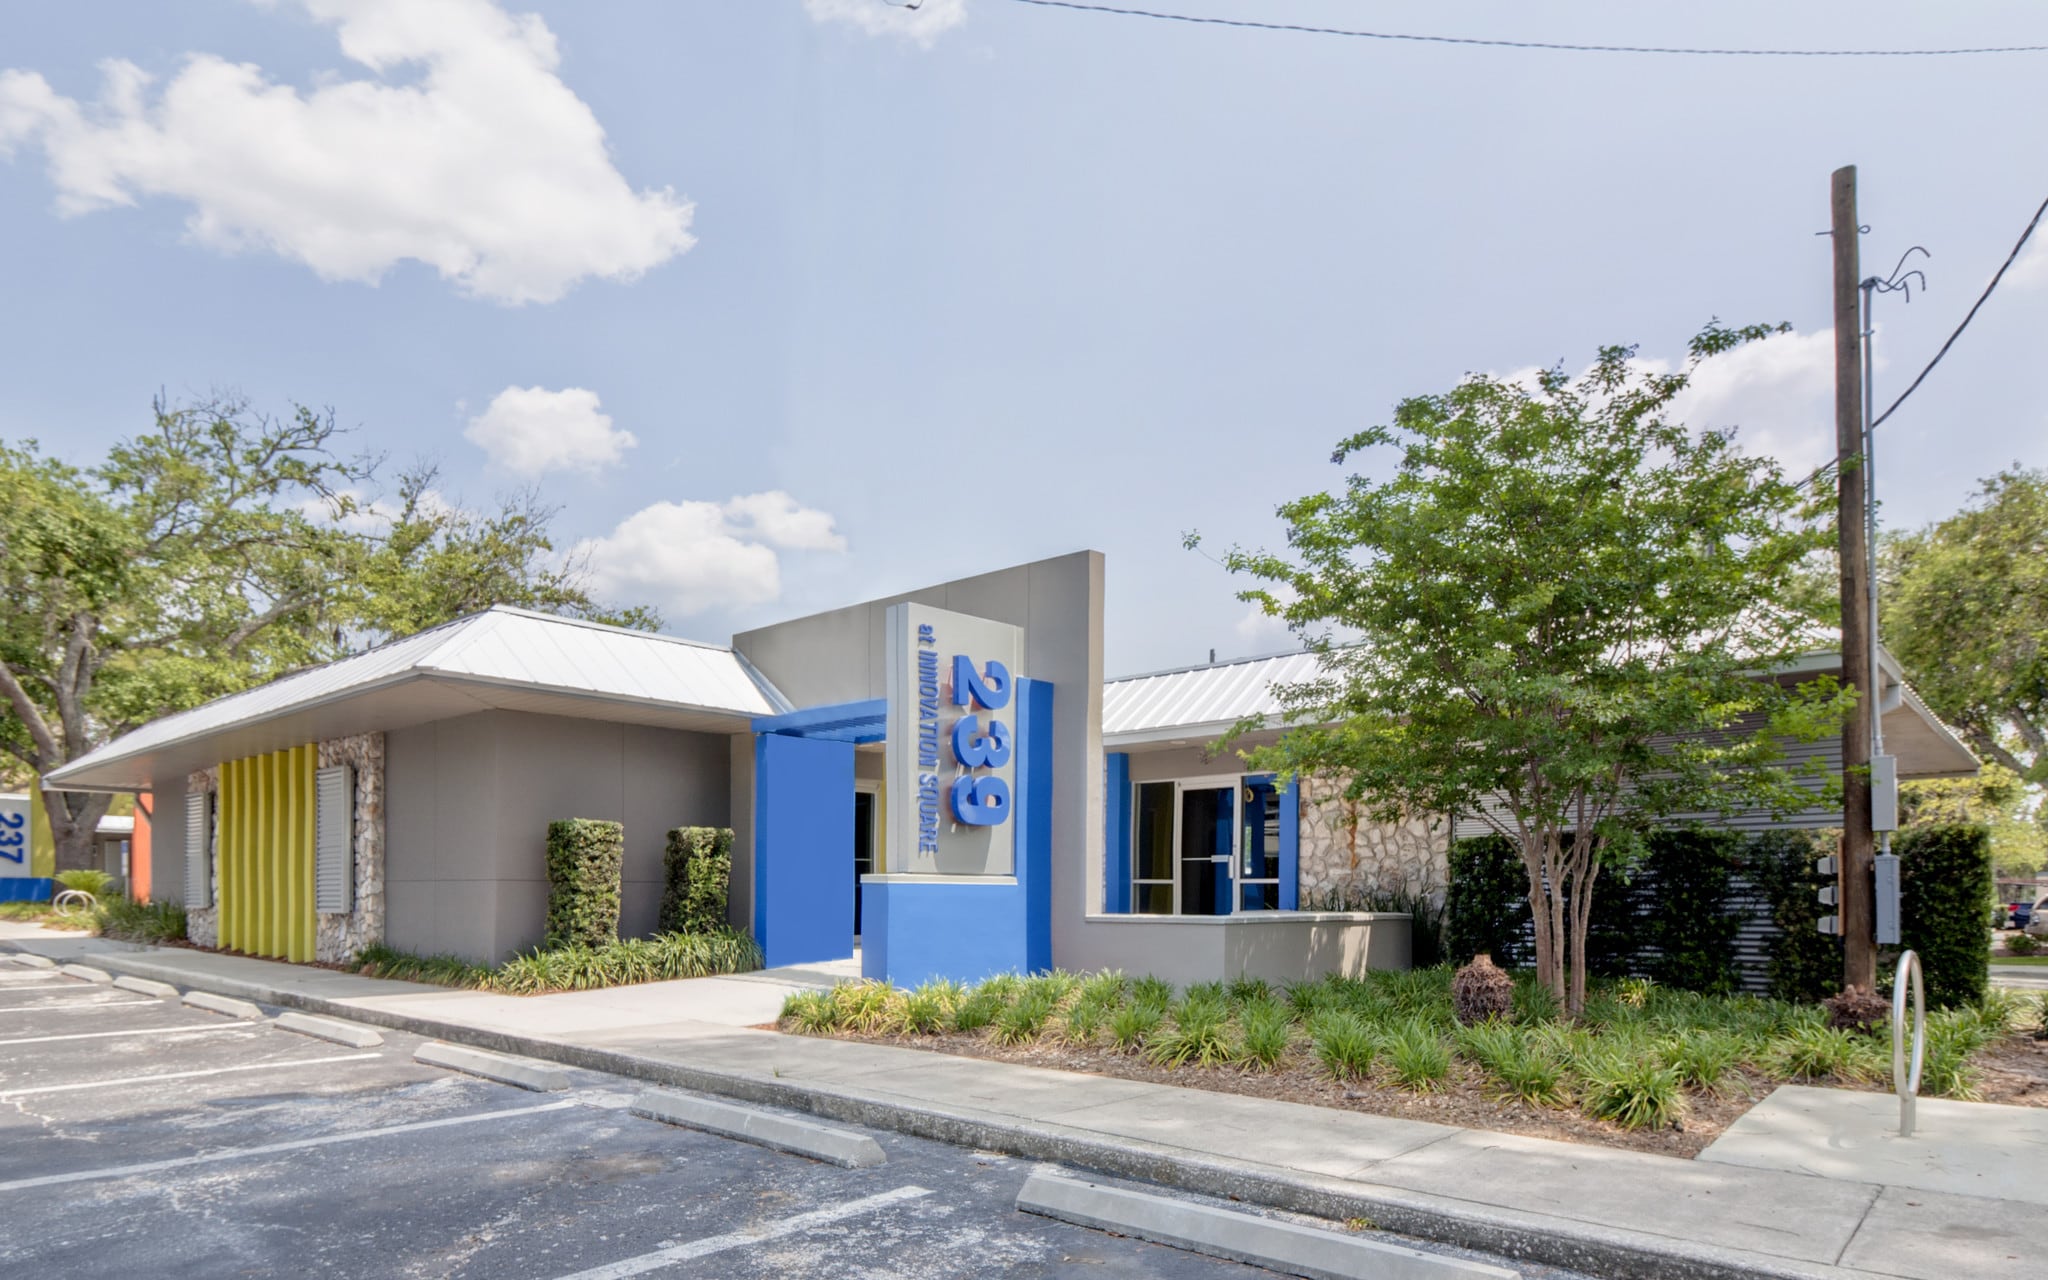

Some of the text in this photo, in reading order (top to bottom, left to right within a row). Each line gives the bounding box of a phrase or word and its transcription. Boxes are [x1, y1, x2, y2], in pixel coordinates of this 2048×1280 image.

[918, 623, 939, 853] at INNOVATION SQUARE
[951, 655, 1011, 826] 239
[0, 813, 24, 864] 237
